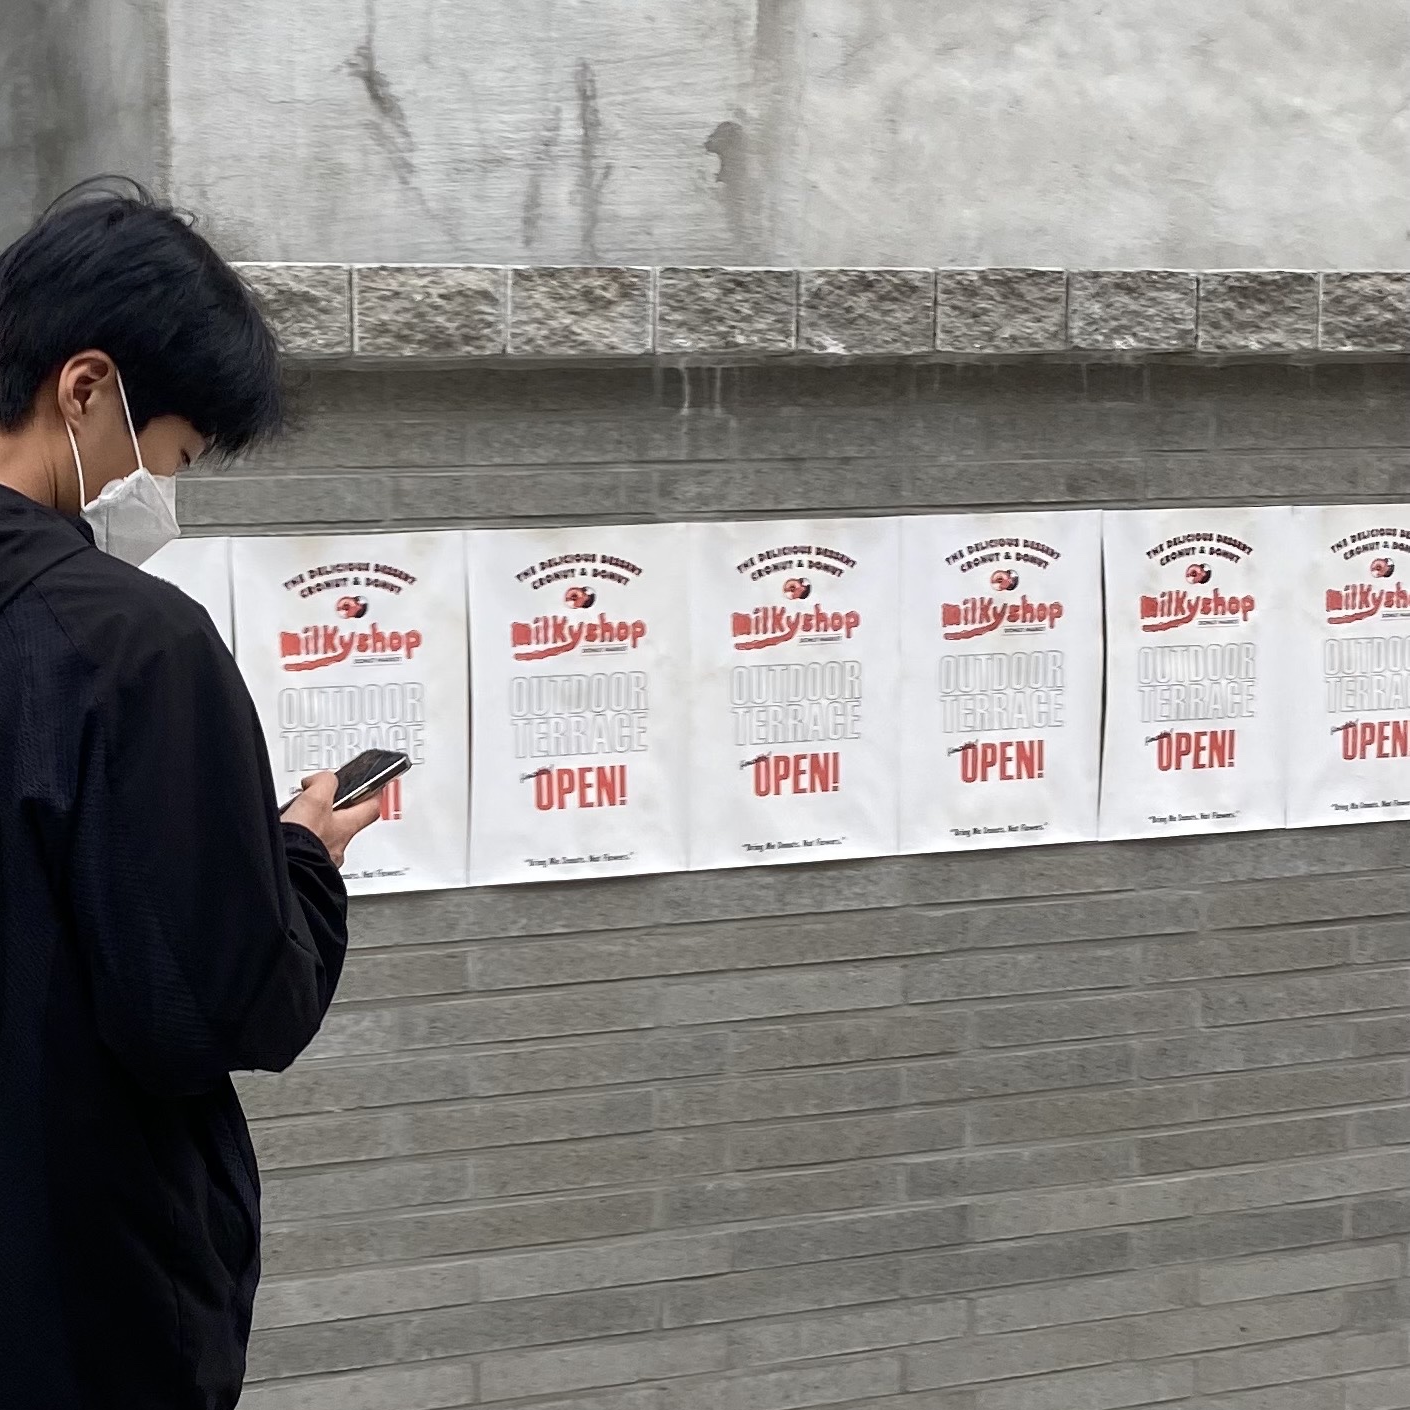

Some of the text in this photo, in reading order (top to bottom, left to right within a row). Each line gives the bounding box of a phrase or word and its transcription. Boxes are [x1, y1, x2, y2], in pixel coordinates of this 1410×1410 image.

[939, 650, 1065, 694] OUTDOOR
[1138, 642, 1256, 684] OUTDOOR
[1324, 635, 1410, 675] OUTDO
[510, 671, 649, 717] OUTDOOR
[731, 660, 862, 705] OUTDOOR
[1138, 680, 1255, 723] TERRACE
[1325, 673, 1410, 713] TERRA
[278, 682, 425, 729] OUTDOOR
[730, 701, 861, 746] TERRACE
[940, 689, 1065, 733] TERRACE
[510, 711, 648, 759] TERRACE
[1157, 730, 1235, 772] OPEN!
[1342, 720, 1410, 760] OPEN
[754, 752, 840, 796] OPEN!
[961, 740, 1044, 783] OPEN!
[534, 765, 628, 811] OPEN!
